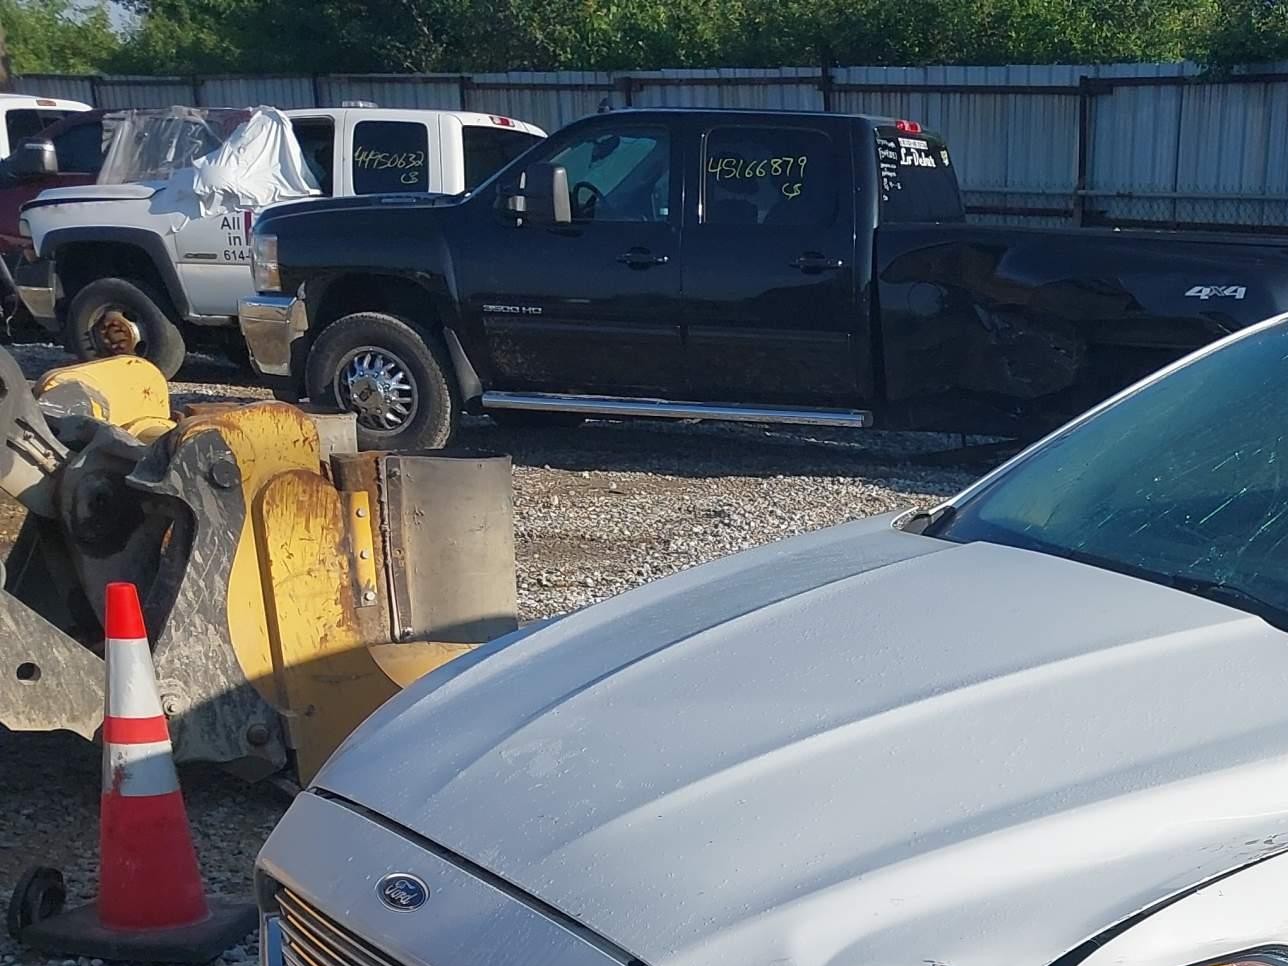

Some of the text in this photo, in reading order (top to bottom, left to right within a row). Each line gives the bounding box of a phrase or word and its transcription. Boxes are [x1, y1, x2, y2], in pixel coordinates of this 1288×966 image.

[707, 156, 808, 181] 45166879
[220, 216, 241, 231] All
[384, 879, 419, 905] Ford
